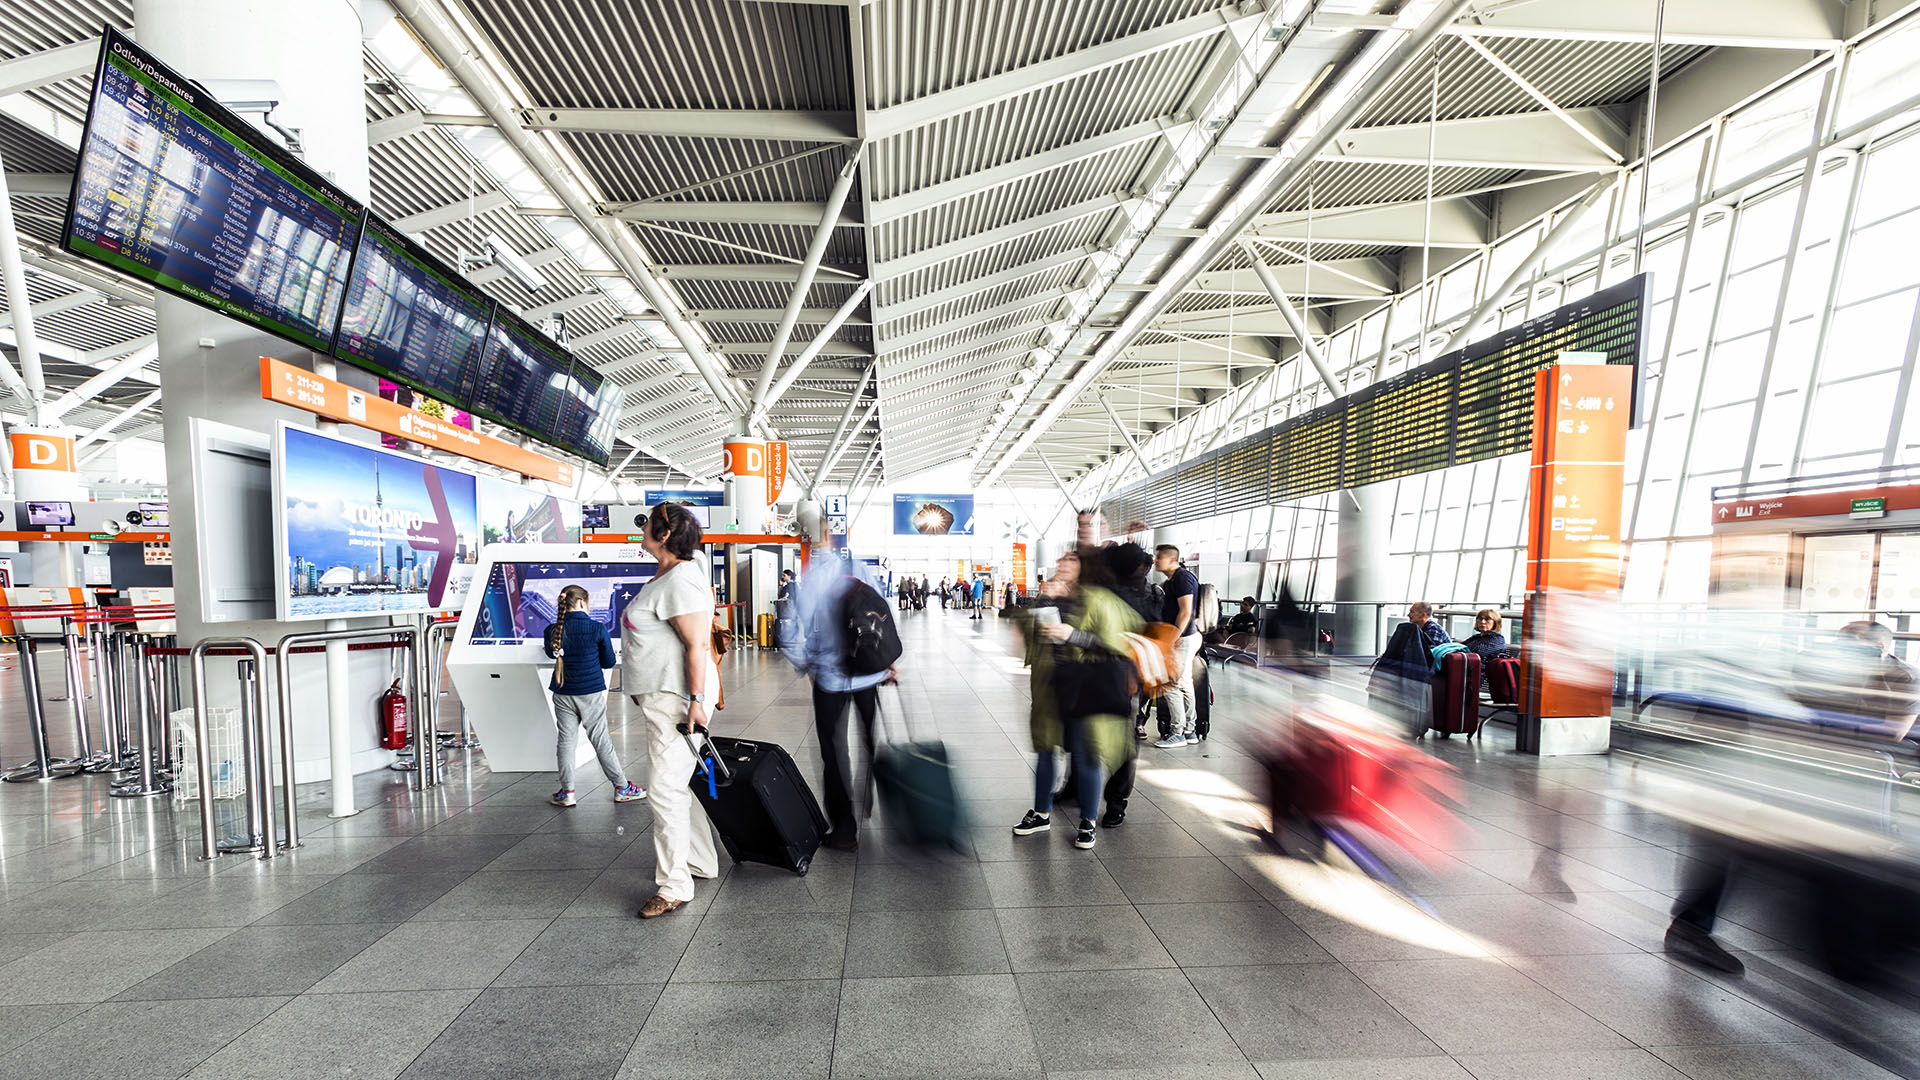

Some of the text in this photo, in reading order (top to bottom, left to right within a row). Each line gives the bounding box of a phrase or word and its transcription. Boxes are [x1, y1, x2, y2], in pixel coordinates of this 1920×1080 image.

[107, 64, 129, 84] 09:30
[110, 53, 130, 72] Time
[149, 79, 171, 101] Flight
[113, 42, 194, 103] Odloty/Departures
[103, 83, 125, 102] 09:40
[149, 112, 159, 124] LX
[163, 120, 179, 136] 1343
[105, 73, 127, 93] 09:40
[132, 92, 147, 105] LOT
[151, 103, 162, 115] LO
[164, 111, 176, 124] 611
[185, 125, 196, 138] OU
[237, 158, 257, 177] Zagreb
[118, 166, 132, 178] LOT
[119, 156, 133, 169] LOT
[114, 184, 128, 196] LOT
[115, 174, 130, 187] LOT
[78, 206, 100, 222] 10:50
[105, 219, 120, 231] LOT
[124, 227, 136, 239] LO
[109, 202, 124, 214] LOT
[128, 210, 139, 221] LO
[76, 215, 98, 232] 10:50
[104, 229, 118, 240] LOT
[122, 237, 134, 248] LO
[136, 242, 149, 255] 771
[80, 197, 102, 214] 10:45
[107, 210, 122, 223] LOT
[126, 219, 137, 230] LO
[173, 241, 189, 254] 3701
[74, 225, 97, 242] 10:55
[134, 252, 150, 265] 5141
[181, 283, 198, 297] Strefa
[198, 291, 220, 307] Odpraw
[29, 440, 58, 465] D
[747, 448, 762, 471] D
[348, 503, 423, 531] TORONTO
[1759, 501, 1783, 510] Wyjście
